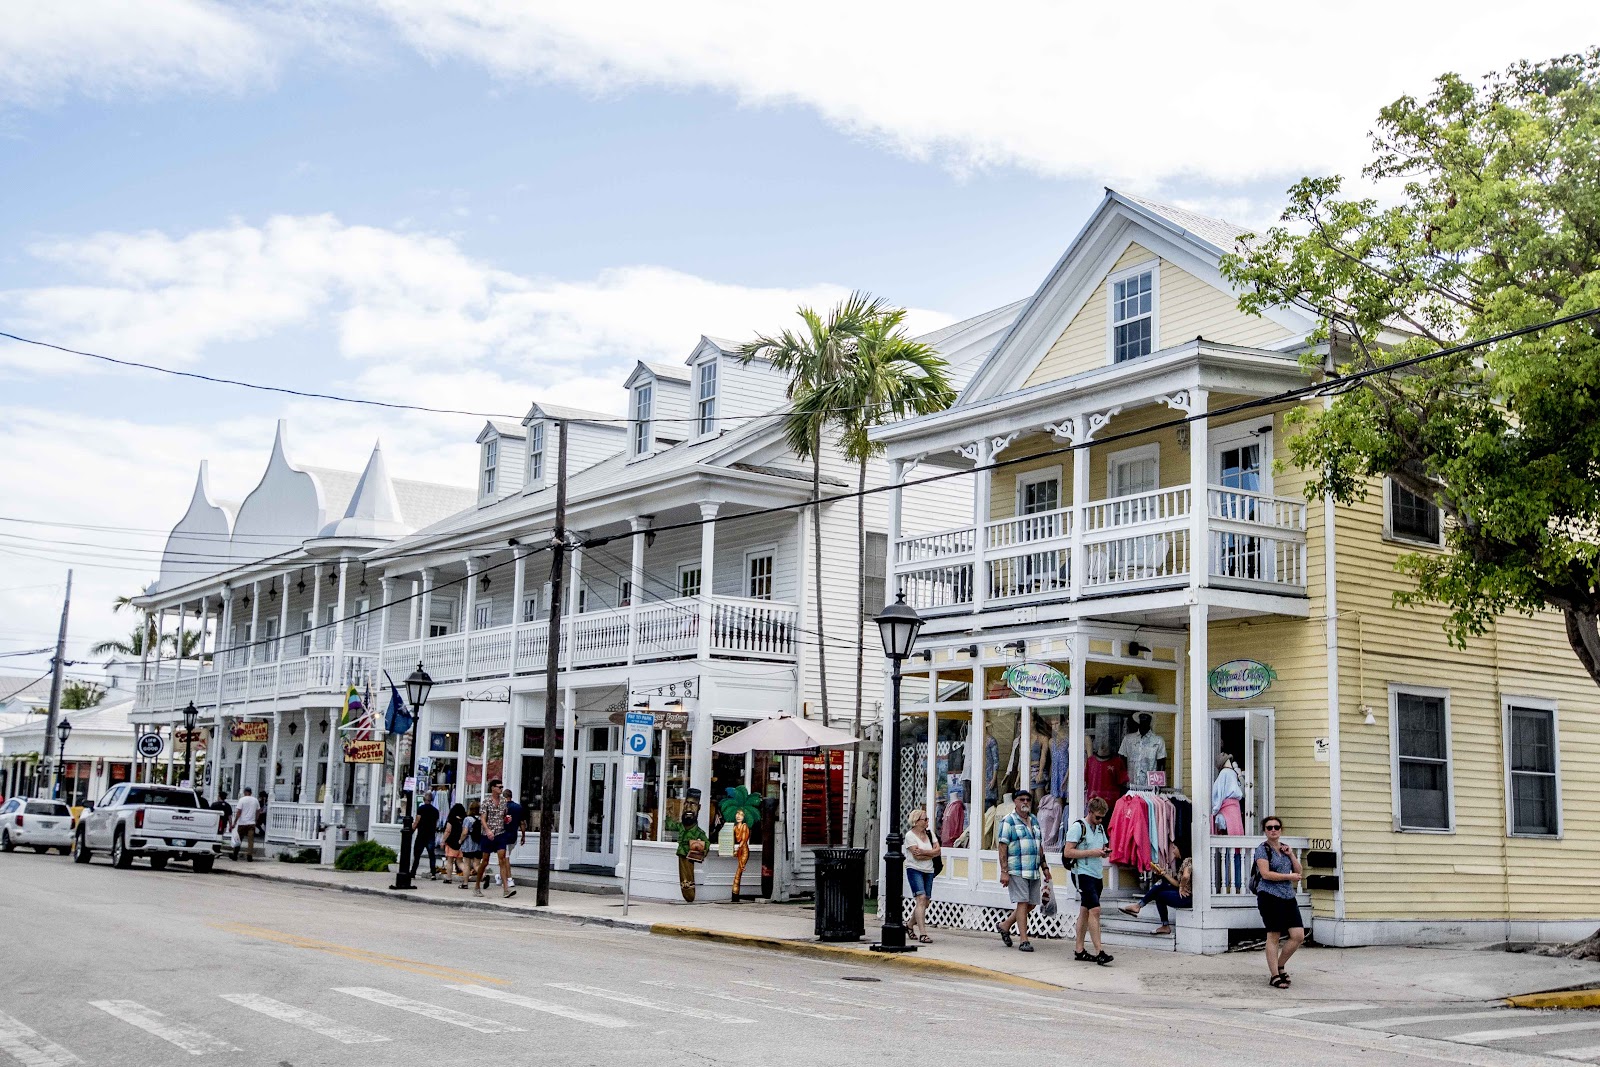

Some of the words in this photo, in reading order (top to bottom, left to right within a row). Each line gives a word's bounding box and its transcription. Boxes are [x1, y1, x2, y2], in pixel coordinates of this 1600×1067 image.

[358, 743, 381, 751] HAPPY
[634, 736, 643, 748] P
[1312, 839, 1331, 850] 1100
